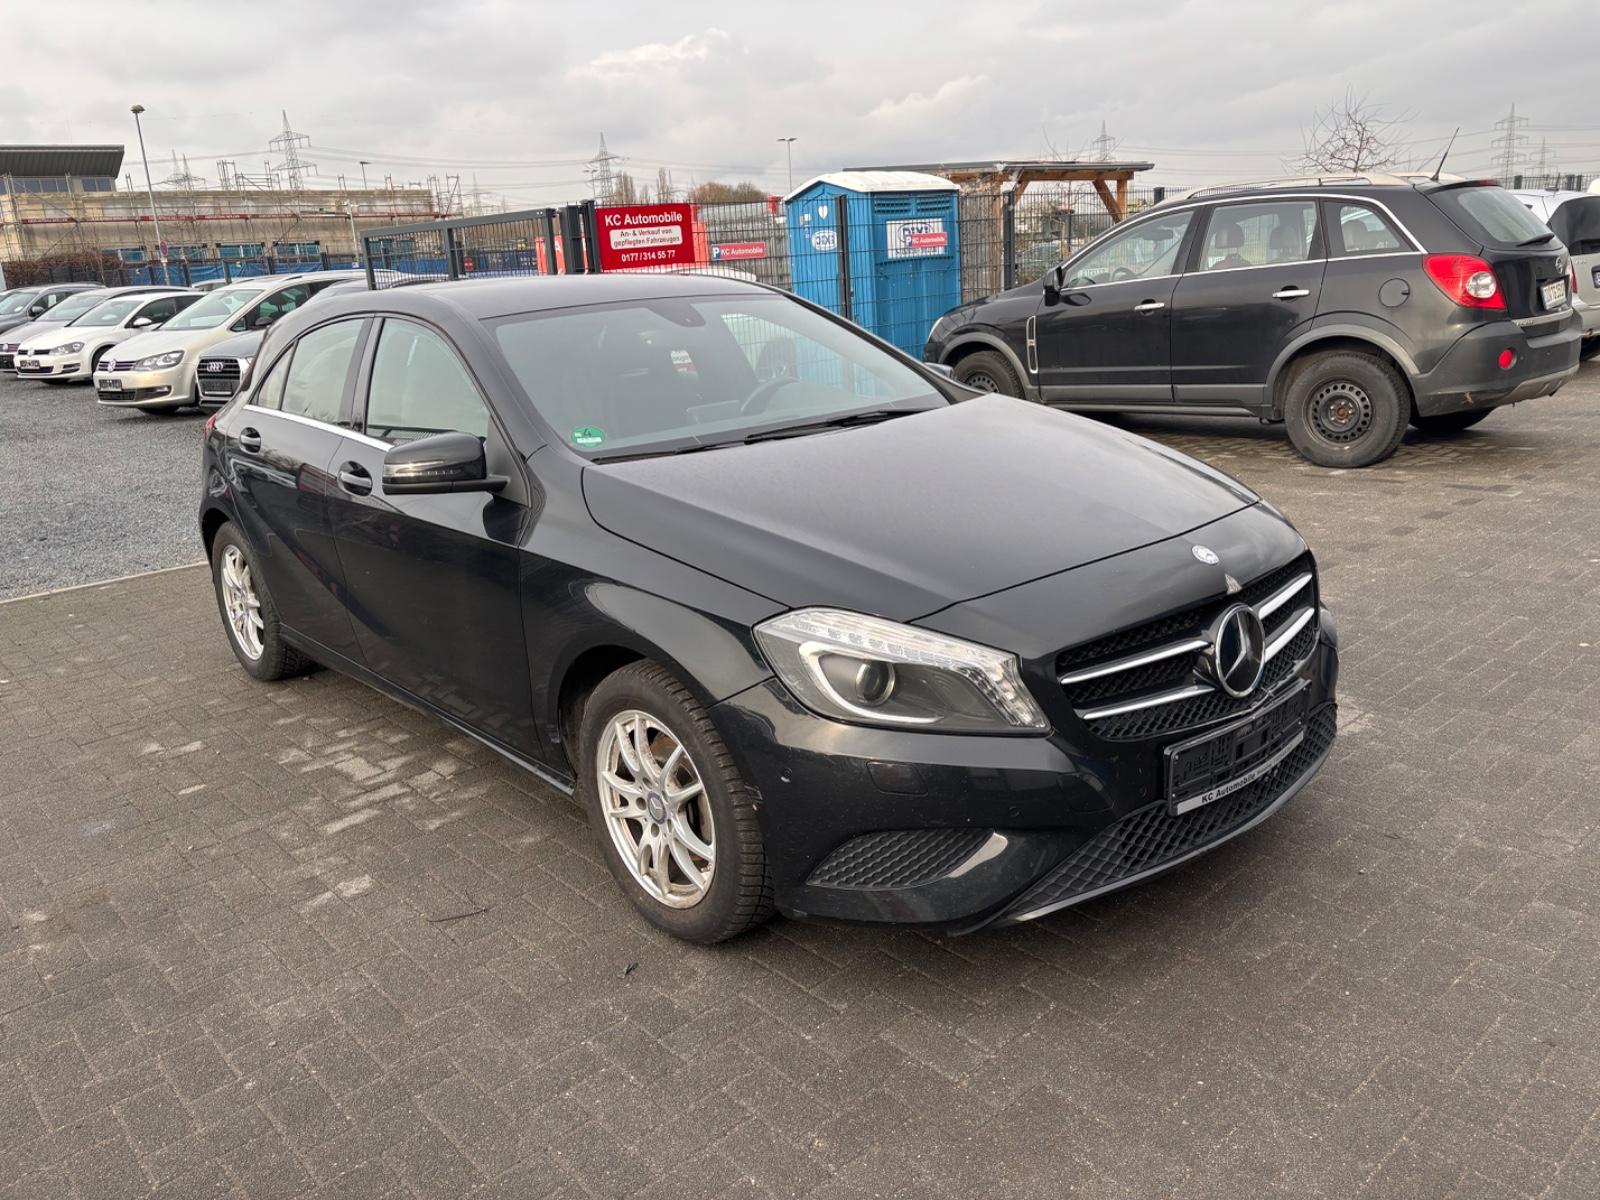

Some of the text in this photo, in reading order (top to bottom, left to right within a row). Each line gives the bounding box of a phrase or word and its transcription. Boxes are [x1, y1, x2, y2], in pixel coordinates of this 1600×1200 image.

[604, 211, 683, 227] KC Automobile
[906, 236, 912, 245] P
[657, 250, 666, 259] 55
[666, 249, 676, 259] 77
[712, 246, 720, 258] P
[1201, 772, 1256, 804] KC Automobile
